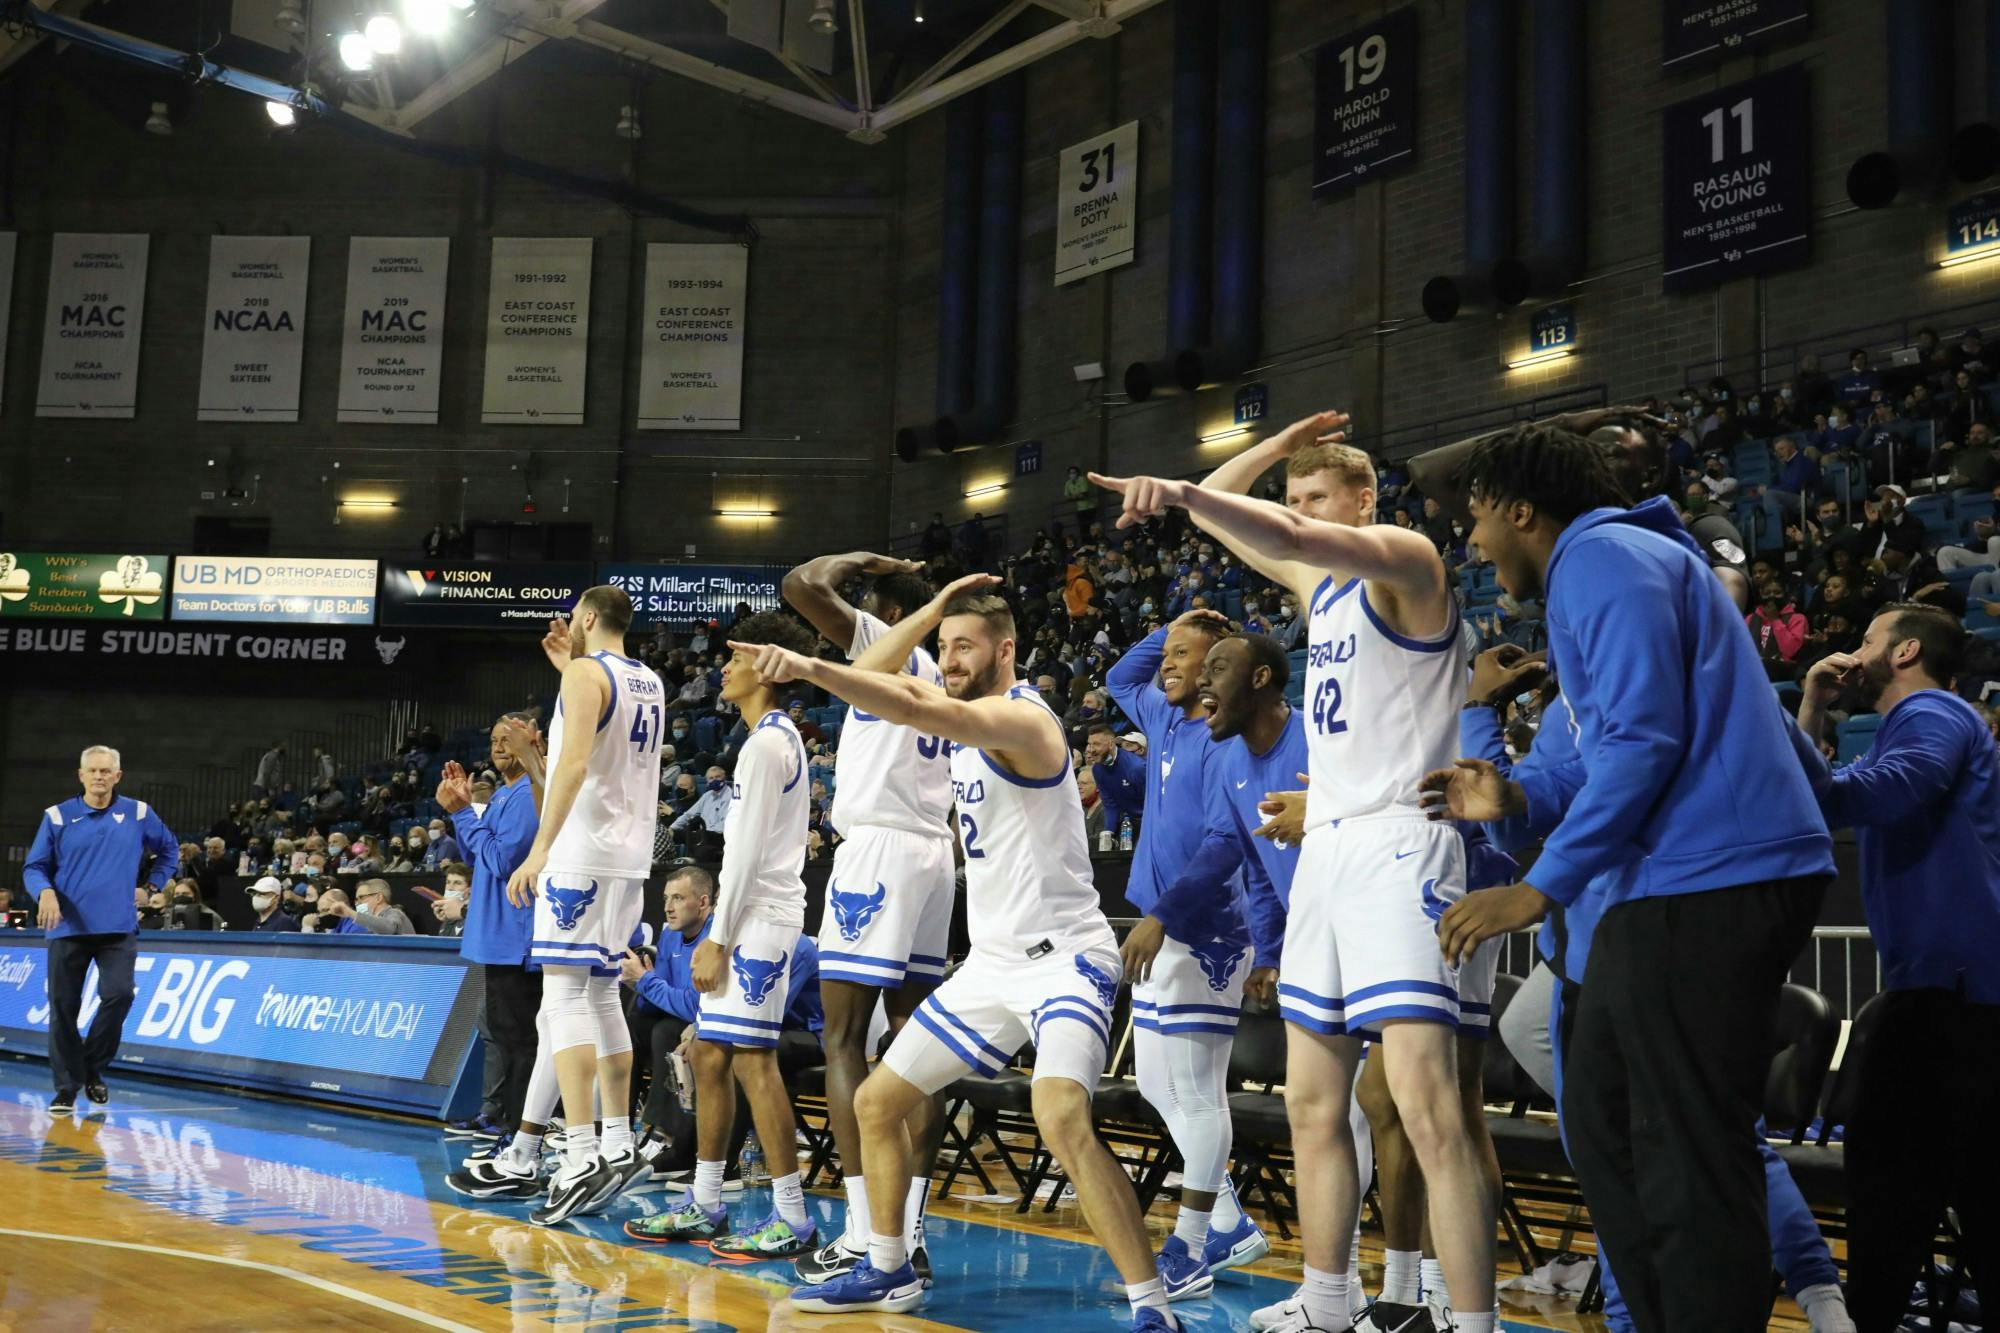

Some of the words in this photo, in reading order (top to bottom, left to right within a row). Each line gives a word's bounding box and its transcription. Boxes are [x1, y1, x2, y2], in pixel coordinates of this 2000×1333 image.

[1682, 8, 1713, 27] MEN'S
[1339, 34, 1388, 93] 19
[1334, 87, 1391, 120] HAROLD
[1342, 107, 1381, 133] KUHN
[1349, 123, 1398, 147] BASKETBALL
[1701, 97, 1756, 164] 11
[1078, 142, 1115, 194] 31
[1693, 160, 1772, 197] RASAUN
[1073, 192, 1119, 217] BRENNA
[1698, 182, 1767, 214] YOUNG
[1081, 208, 1111, 228] DOTY
[1682, 219, 1713, 240] MEN'S
[1715, 203, 1785, 231] BASKETBALL
[1709, 222, 1757, 243] 1993-1998
[1959, 217, 2000, 245] 114
[379, 257, 419, 265] WOMEN'S
[231, 271, 284, 279] BASKETBALL
[371, 265, 424, 273] BASKETBALL
[514, 273, 567, 283] 1991-1992
[667, 280, 723, 289] 1993-1994
[243, 297, 270, 307] 2018
[383, 297, 409, 307] 2019
[504, 301, 533, 310] EAST
[536, 301, 576, 310] COAST
[61, 305, 126, 326] MAC
[659, 307, 688, 316] EAST
[691, 307, 731, 317] COAST
[213, 310, 294, 332] NCAA
[361, 309, 427, 332] MAC
[500, 314, 577, 324] CONFERENCE
[656, 320, 733, 329] CONFERENCE
[60, 329, 125, 339] CHAMPIONS
[504, 327, 573, 336] CHAMPIONS
[660, 332, 729, 342] CHAMPIONS
[1539, 325, 1566, 347] 113
[360, 334, 426, 344] CHAMPIONS
[75, 361, 103, 369] NCAA
[233, 363, 268, 372] SWEET
[377, 358, 406, 366] NCAA
[54, 371, 122, 381] TOURNAMENT
[356, 367, 425, 377] TOURNAMENT
[514, 366, 556, 375] WOMEN'S
[670, 372, 713, 380] WOMEN'S
[229, 374, 272, 384] SIXTEEN
[507, 374, 563, 383] BASKETBALL
[663, 380, 719, 388] BASKETBALL
[1240, 401, 1261, 420] 112
[1021, 457, 1037, 473] 111
[46, 556, 88, 566] WNY's
[50, 571, 77, 582] Best
[180, 564, 217, 585] UB
[224, 565, 262, 585] MD
[266, 566, 376, 580] ORTHOPAEDICS
[443, 570, 492, 583] VISION
[39, 586, 88, 598] Reuben
[650, 576, 705, 593] Millard
[710, 578, 775, 595] Fillmore
[440, 586, 516, 600] FINANCIAL
[520, 587, 571, 601] GROUP
[29, 601, 94, 614] Sandwich
[177, 598, 208, 611] Team
[210, 599, 257, 612] Doctors
[259, 600, 277, 613] for
[278, 601, 311, 613] Your
[313, 601, 334, 614] UB
[337, 601, 371, 615] Bulls
[648, 596, 726, 613] Suburban
[507, 609, 553, 619] MassMutual
[554, 610, 570, 619] firm
[16, 629, 87, 651] BLUE
[101, 630, 231, 657] STUDENT
[235, 637, 347, 661] CORNER
[1313, 678, 1348, 735] 42
[630, 704, 660, 753] 41
[137, 960, 251, 1044] BIG
